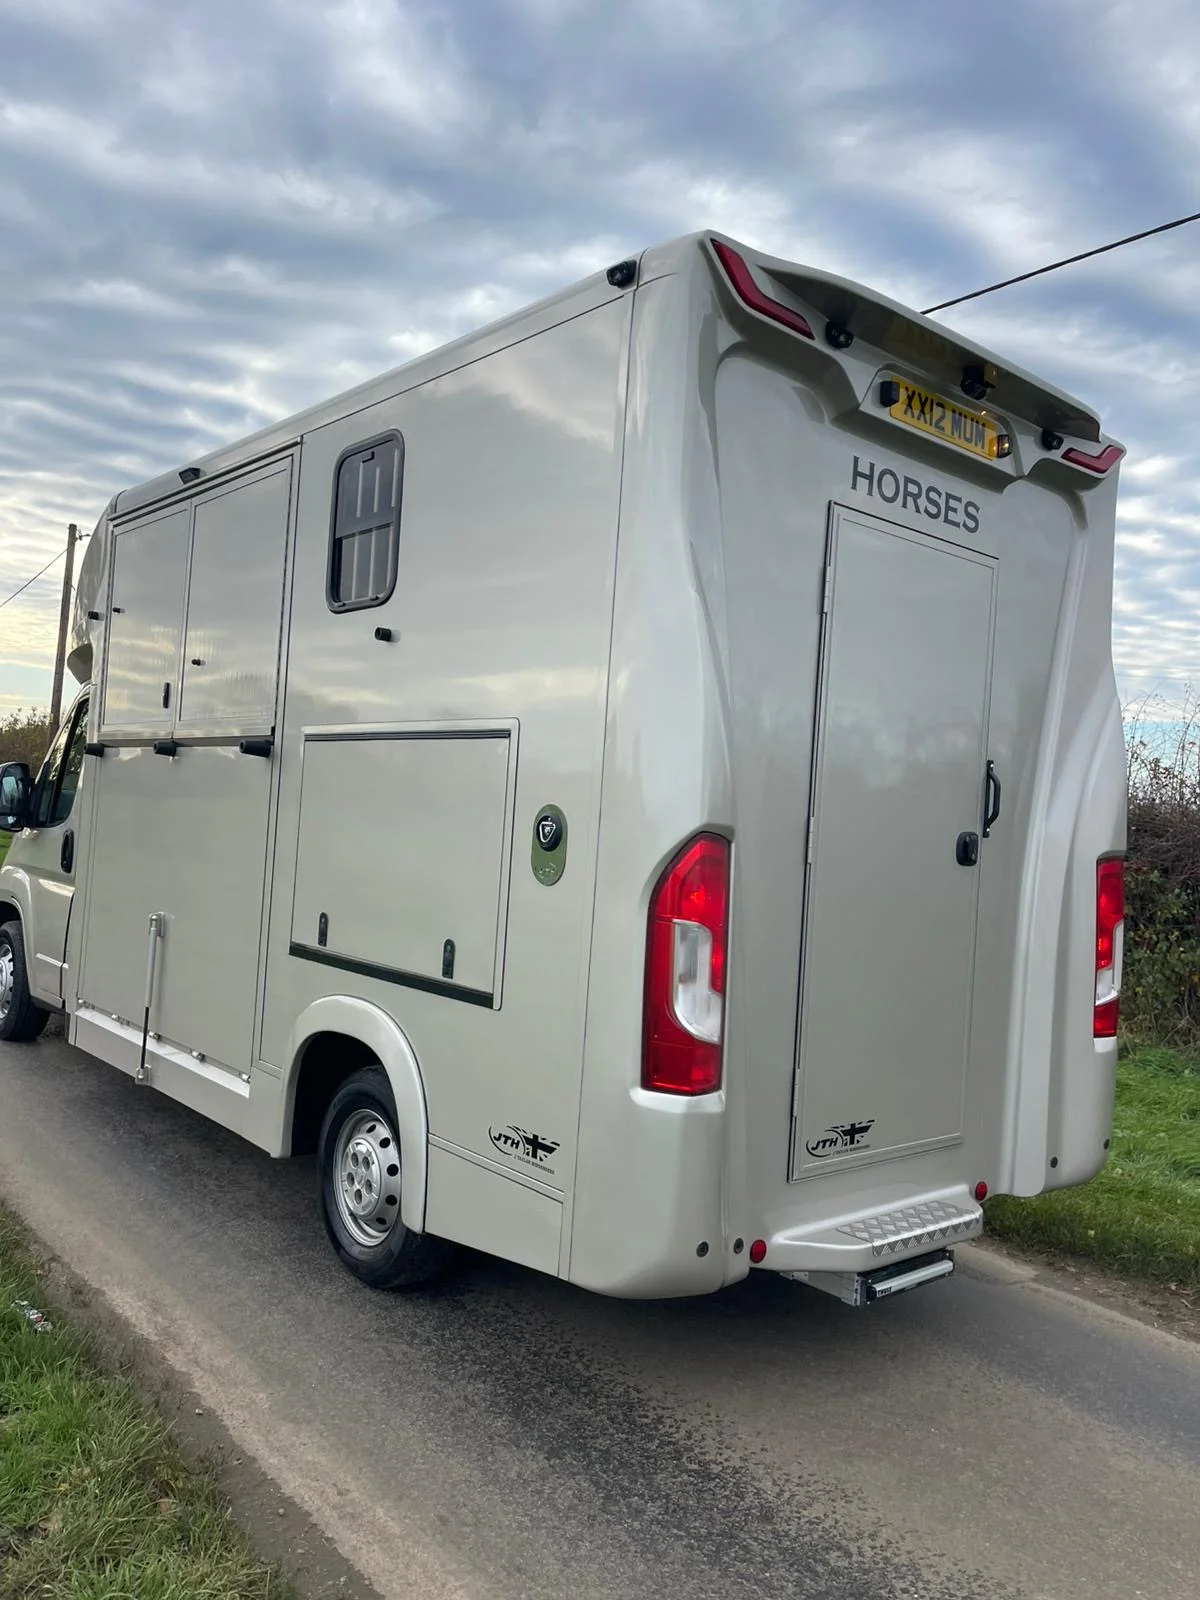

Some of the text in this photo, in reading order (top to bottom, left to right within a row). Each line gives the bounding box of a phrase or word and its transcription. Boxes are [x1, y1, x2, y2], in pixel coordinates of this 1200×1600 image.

[904, 387, 986, 450] XX12 MUM
[851, 455, 980, 533] HORSES
[493, 1133, 521, 1149] JTH
[811, 1137, 838, 1151] JTH
